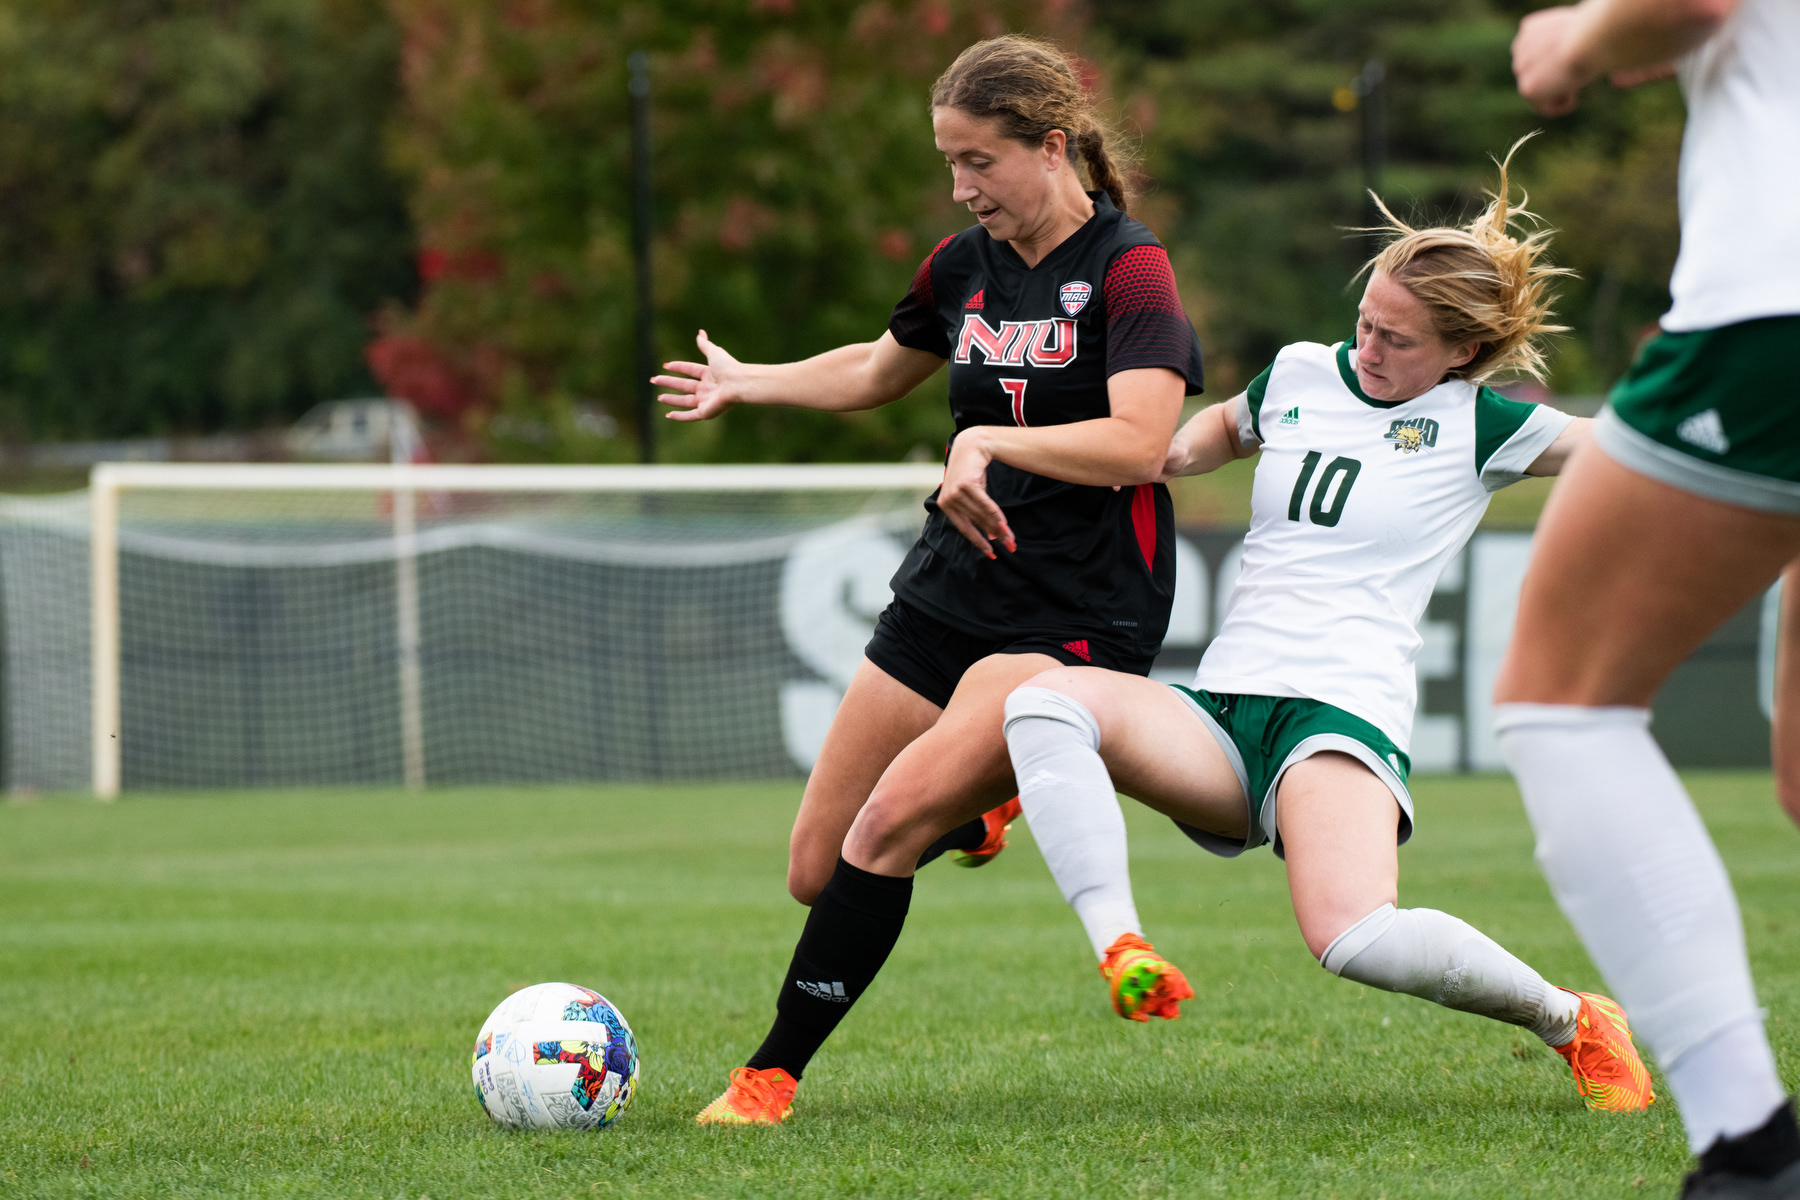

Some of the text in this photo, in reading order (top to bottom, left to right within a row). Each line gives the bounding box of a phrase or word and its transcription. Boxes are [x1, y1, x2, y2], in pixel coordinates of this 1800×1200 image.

[1061, 292, 1089, 302] MAC
[954, 314, 1078, 368] NIU
[1288, 450, 1362, 528] 10
[1062, 643, 1091, 662] adidas
[796, 980, 850, 1003] adidas
